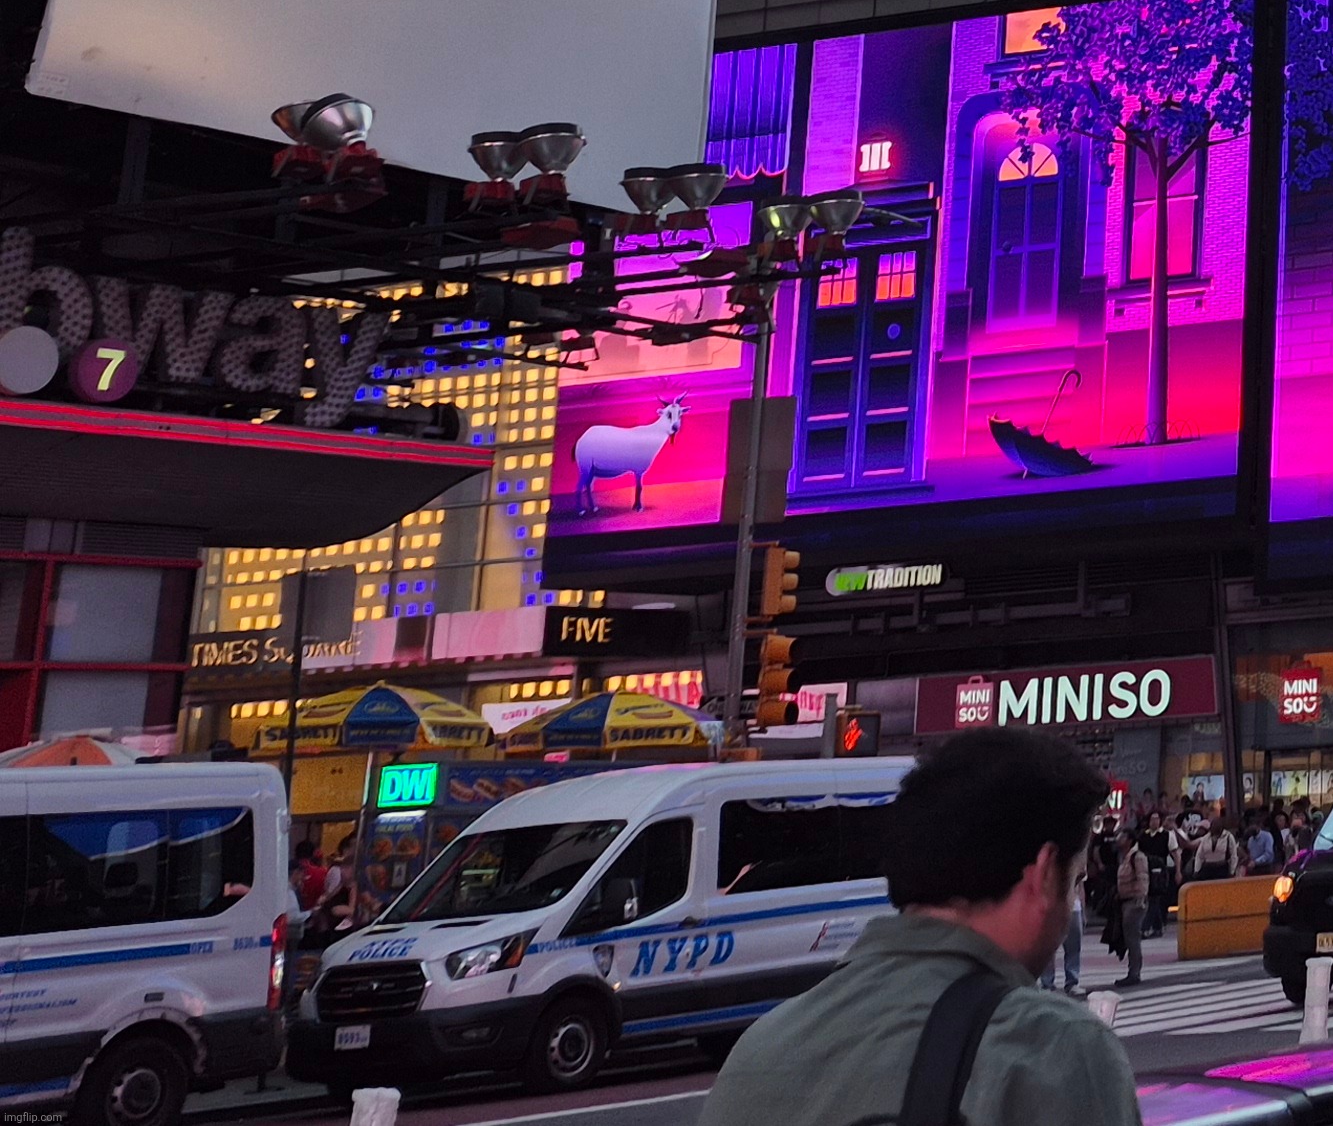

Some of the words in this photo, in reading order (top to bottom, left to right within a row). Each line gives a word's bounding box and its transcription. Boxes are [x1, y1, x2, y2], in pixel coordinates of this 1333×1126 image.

[95, 347, 126, 392] 7
[560, 615, 613, 643] FIVE
[191, 637, 261, 668] TIMES
[959, 689, 991, 706] MINI
[998, 669, 1172, 726] MINISO
[1283, 678, 1318, 695] MINI
[608, 726, 690, 743] SABRETT
[348, 945, 414, 962] POLICE
[538, 938, 577, 954] POLICE
[630, 931, 736, 978] NYPD
